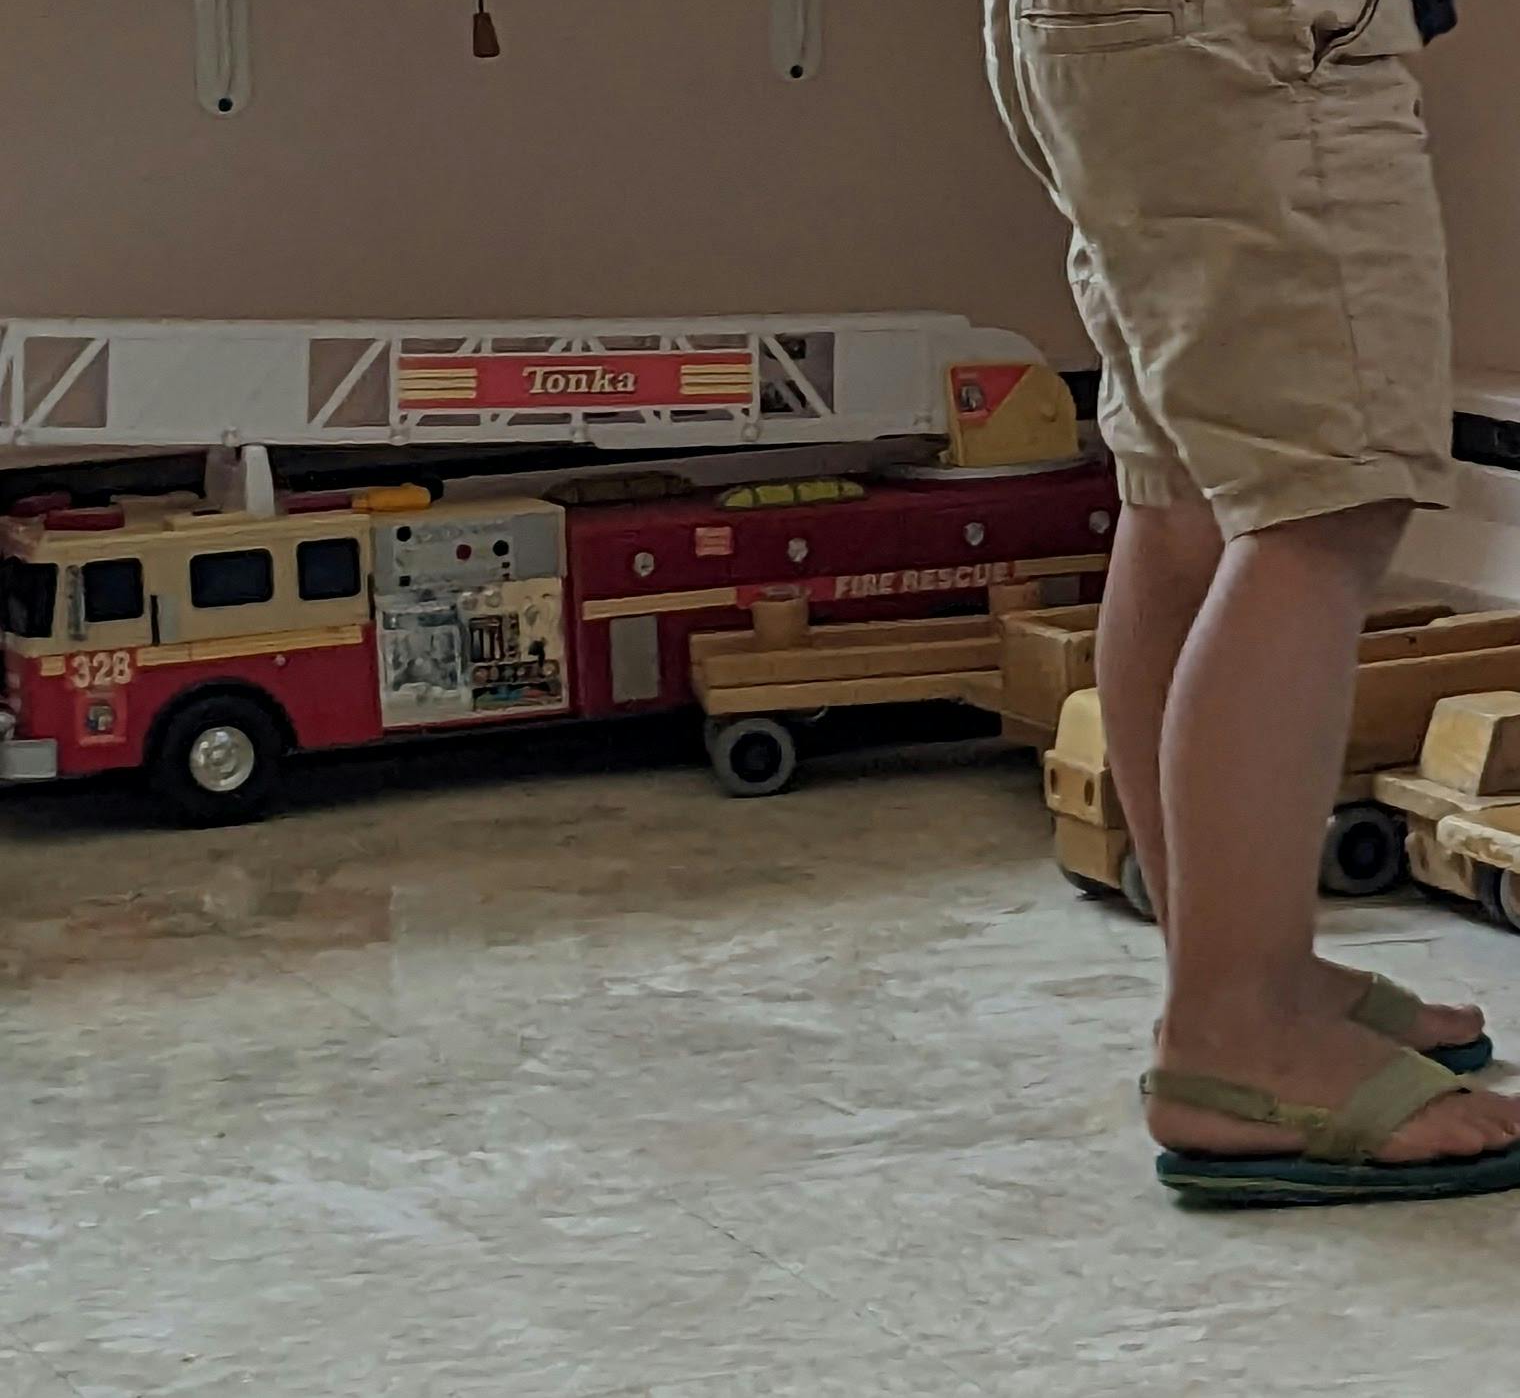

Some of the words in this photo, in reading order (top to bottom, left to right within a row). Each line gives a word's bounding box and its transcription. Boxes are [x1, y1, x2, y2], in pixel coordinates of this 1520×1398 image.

[522, 365, 636, 394] Tonka
[834, 572, 898, 600] FIRE
[901, 561, 1009, 594] RESCUE
[72, 650, 132, 689] 328
